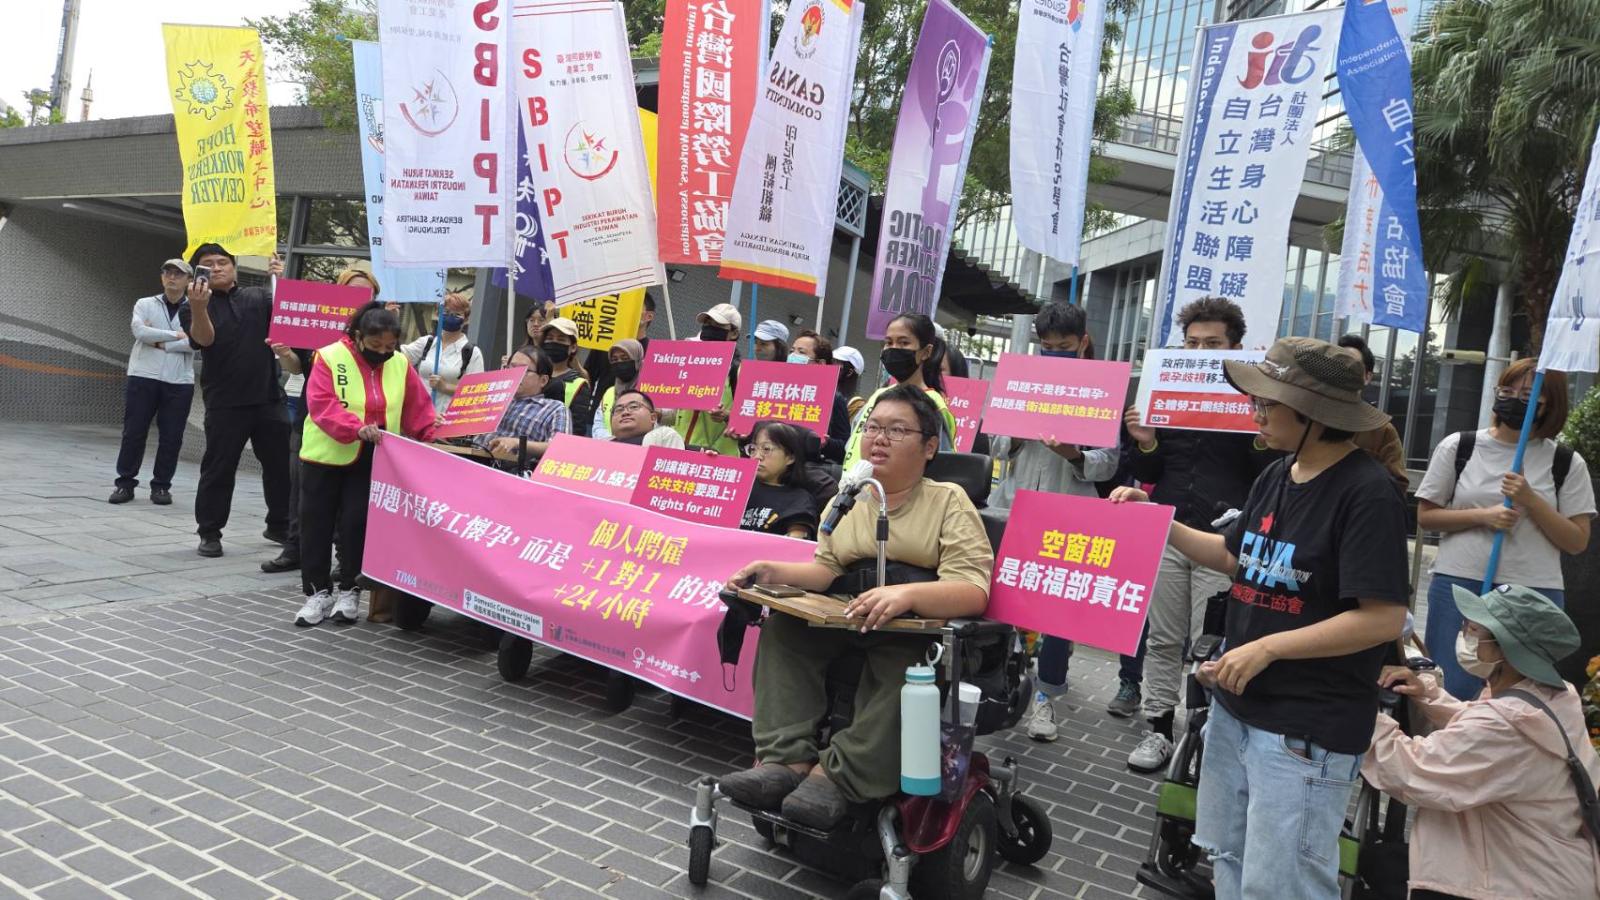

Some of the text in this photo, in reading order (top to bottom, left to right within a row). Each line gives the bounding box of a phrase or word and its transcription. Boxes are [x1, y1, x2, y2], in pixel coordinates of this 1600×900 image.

[1339, 36, 1400, 68] Independent
[1280, 90, 1308, 146] 社團法人
[522, 48, 570, 260] SBIPT
[1184, 97, 1252, 292] 自立生活聯盟
[1219, 93, 1284, 298] 台灣身心障礙
[653, 353, 723, 366] Taking Leaves
[640, 383, 719, 397] Workers' Right!
[752, 381, 817, 402] 請假休假
[949, 396, 970, 409] Are
[739, 399, 823, 424] 是移工權益
[1153, 398, 1251, 415] 全體勞工團結抵抗
[653, 457, 743, 483] 別讓權利互相撞!
[647, 474, 737, 502] 公共支持要跟上!
[649, 494, 723, 518] Rights for all!
[1038, 529, 1117, 569] 空窗期
[394, 570, 418, 588] TIWA
[995, 556, 1147, 615] 是衛福部責任
[473, 595, 541, 625] Domestic Caretaker Union
